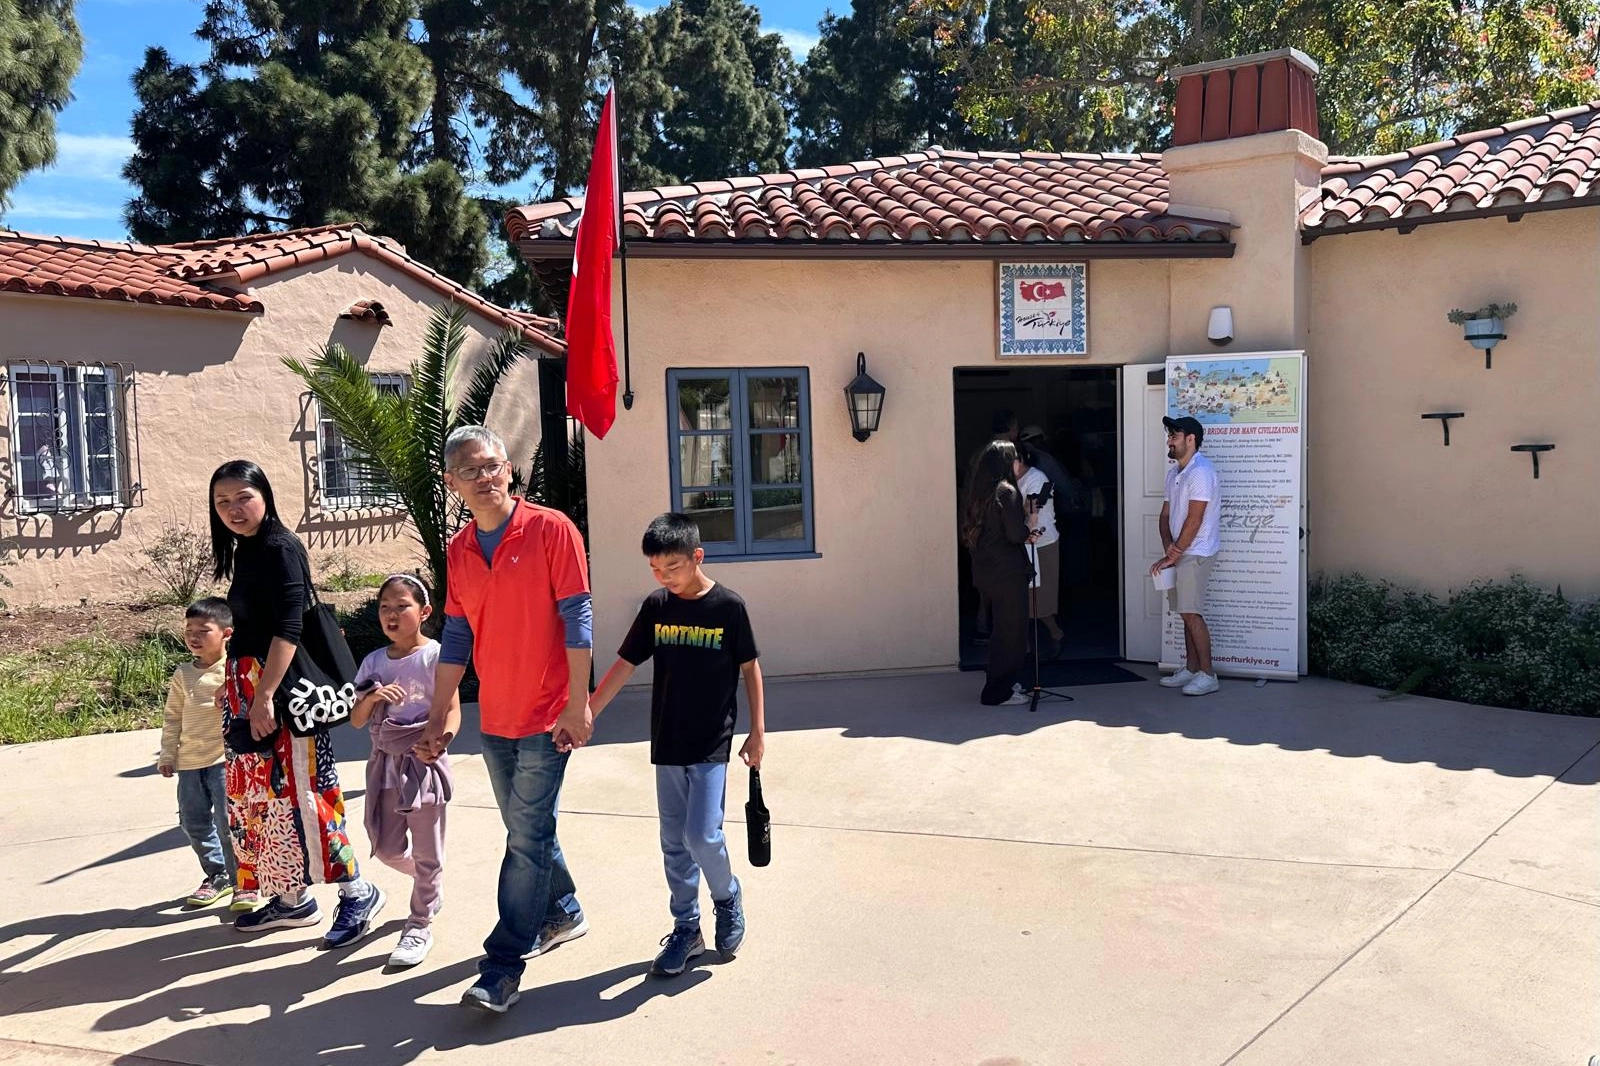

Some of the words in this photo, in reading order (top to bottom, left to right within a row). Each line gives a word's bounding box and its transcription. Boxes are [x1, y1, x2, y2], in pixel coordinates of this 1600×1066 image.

[1207, 427, 1228, 435] BRIDGE
[1229, 427, 1241, 435] FOR
[1241, 426, 1258, 435] MANY
[1257, 426, 1299, 434] CIVILIZATIONS
[654, 623, 724, 650] FORTNITE
